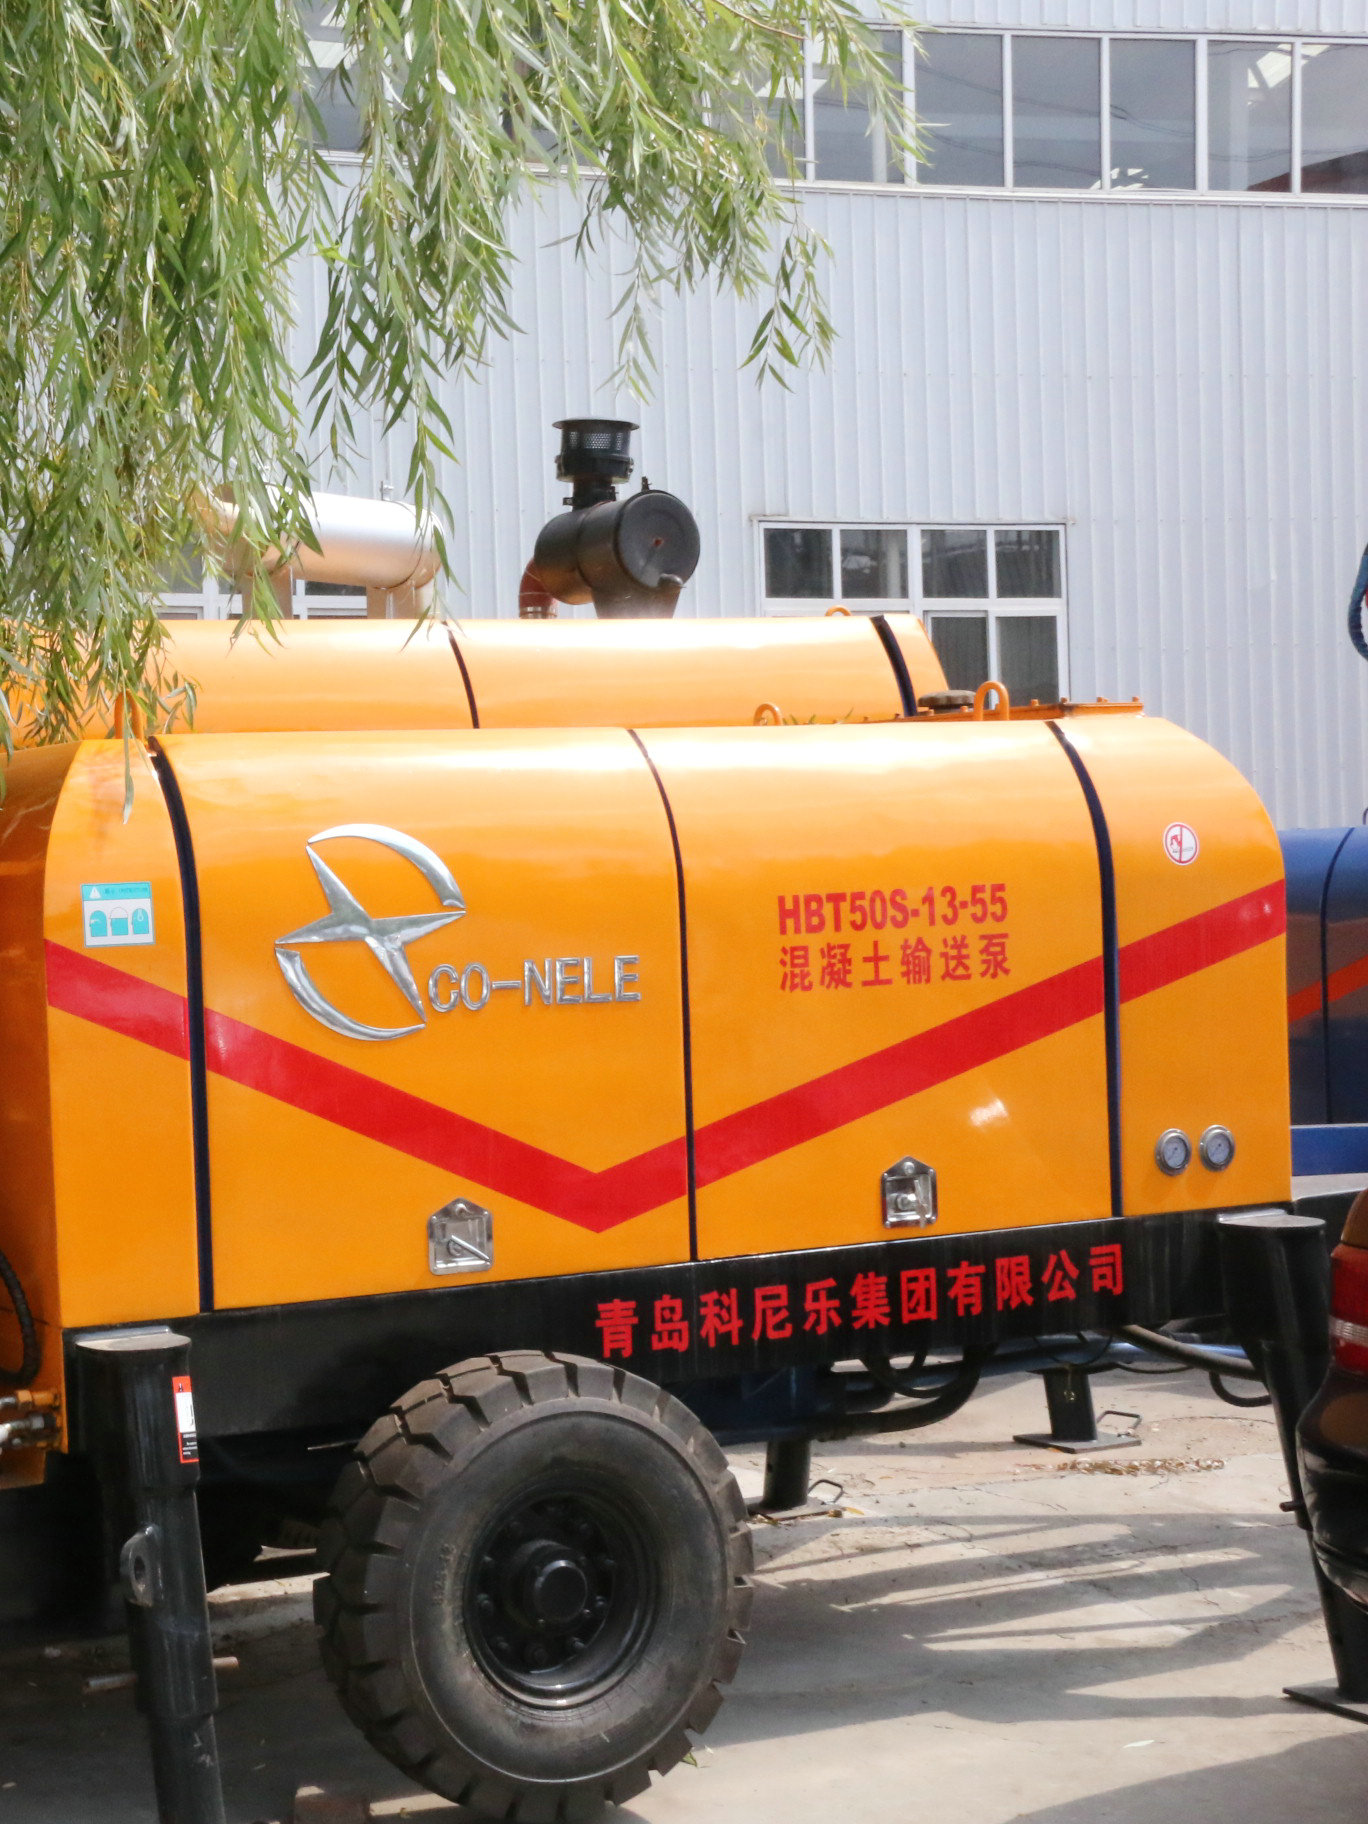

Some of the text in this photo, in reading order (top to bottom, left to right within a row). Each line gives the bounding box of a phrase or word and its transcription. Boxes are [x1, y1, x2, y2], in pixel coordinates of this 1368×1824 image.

[778, 883, 1008, 935] HBT50S-13-55
[428, 955, 641, 1012] CO-NELE
[779, 933, 1011, 992] 混凝土输送泵
[595, 1243, 1124, 1359] 青岛科尼乐集团有限公司
